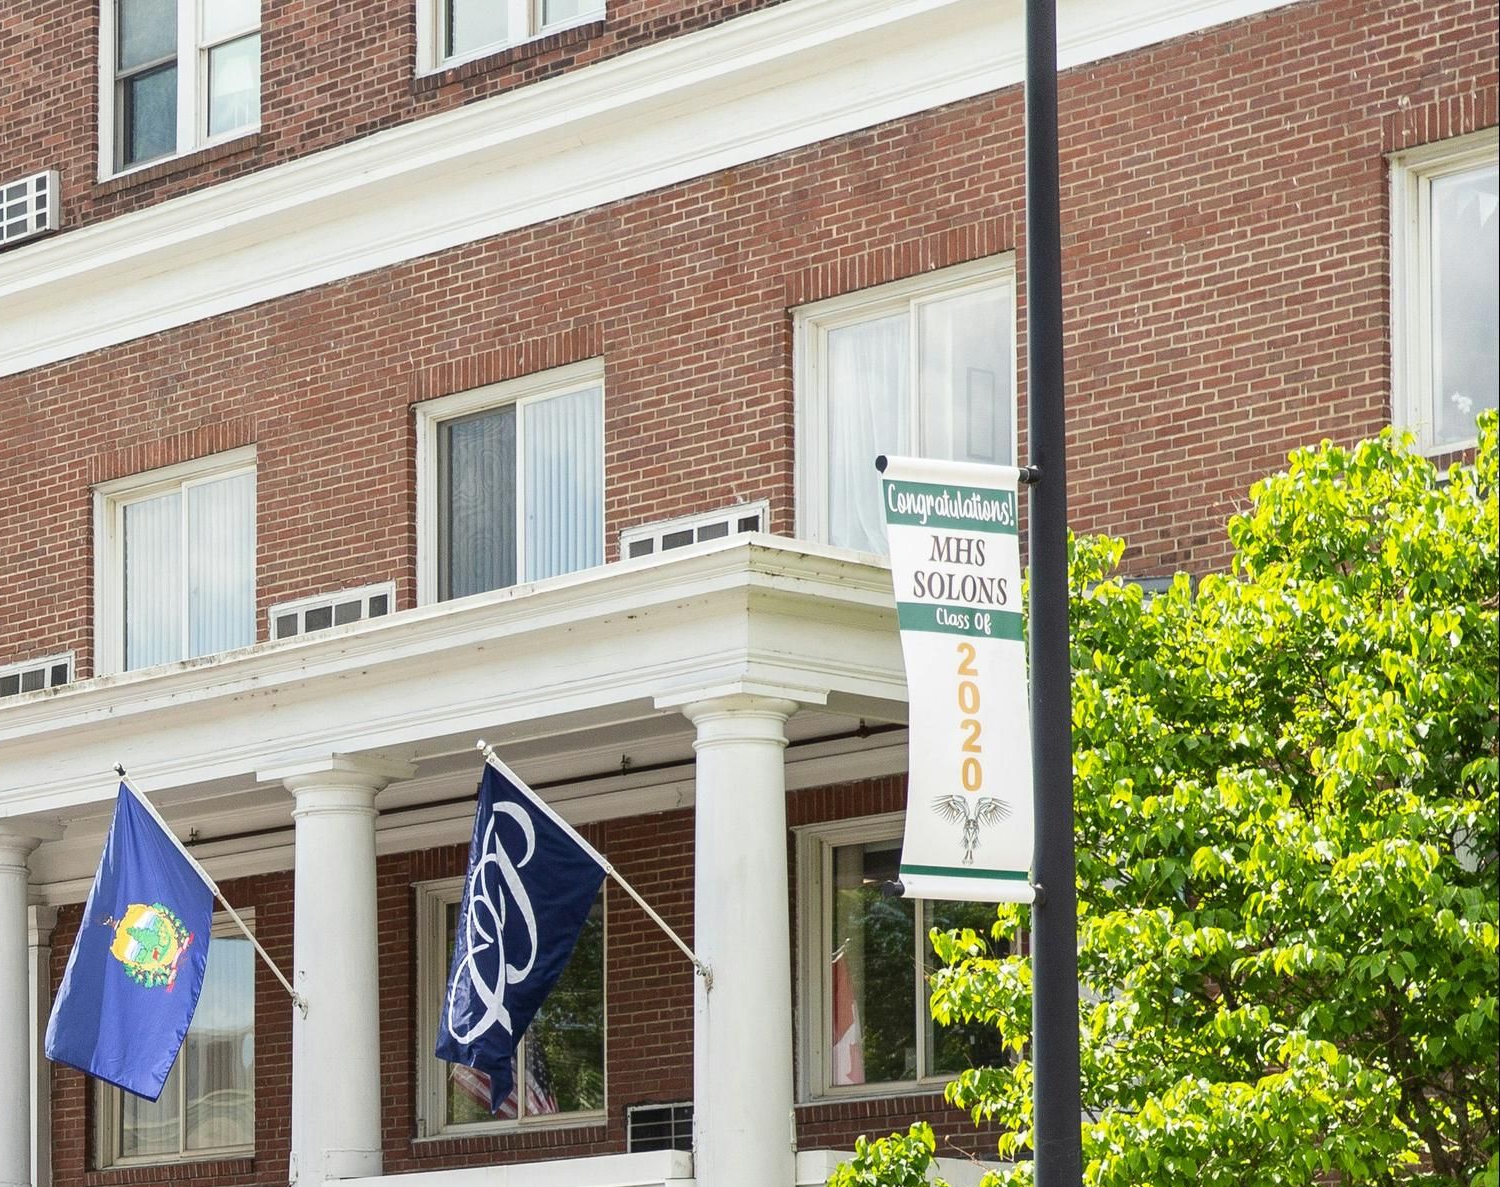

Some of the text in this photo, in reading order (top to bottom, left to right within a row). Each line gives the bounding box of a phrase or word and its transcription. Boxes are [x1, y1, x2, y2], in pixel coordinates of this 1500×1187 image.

[887, 483, 1015, 527] Congratulations!
[929, 534, 986, 568] MHS
[913, 570, 1008, 606] SOLONS
[936, 607, 993, 635] Class Of
[956, 641, 983, 792] 2020
